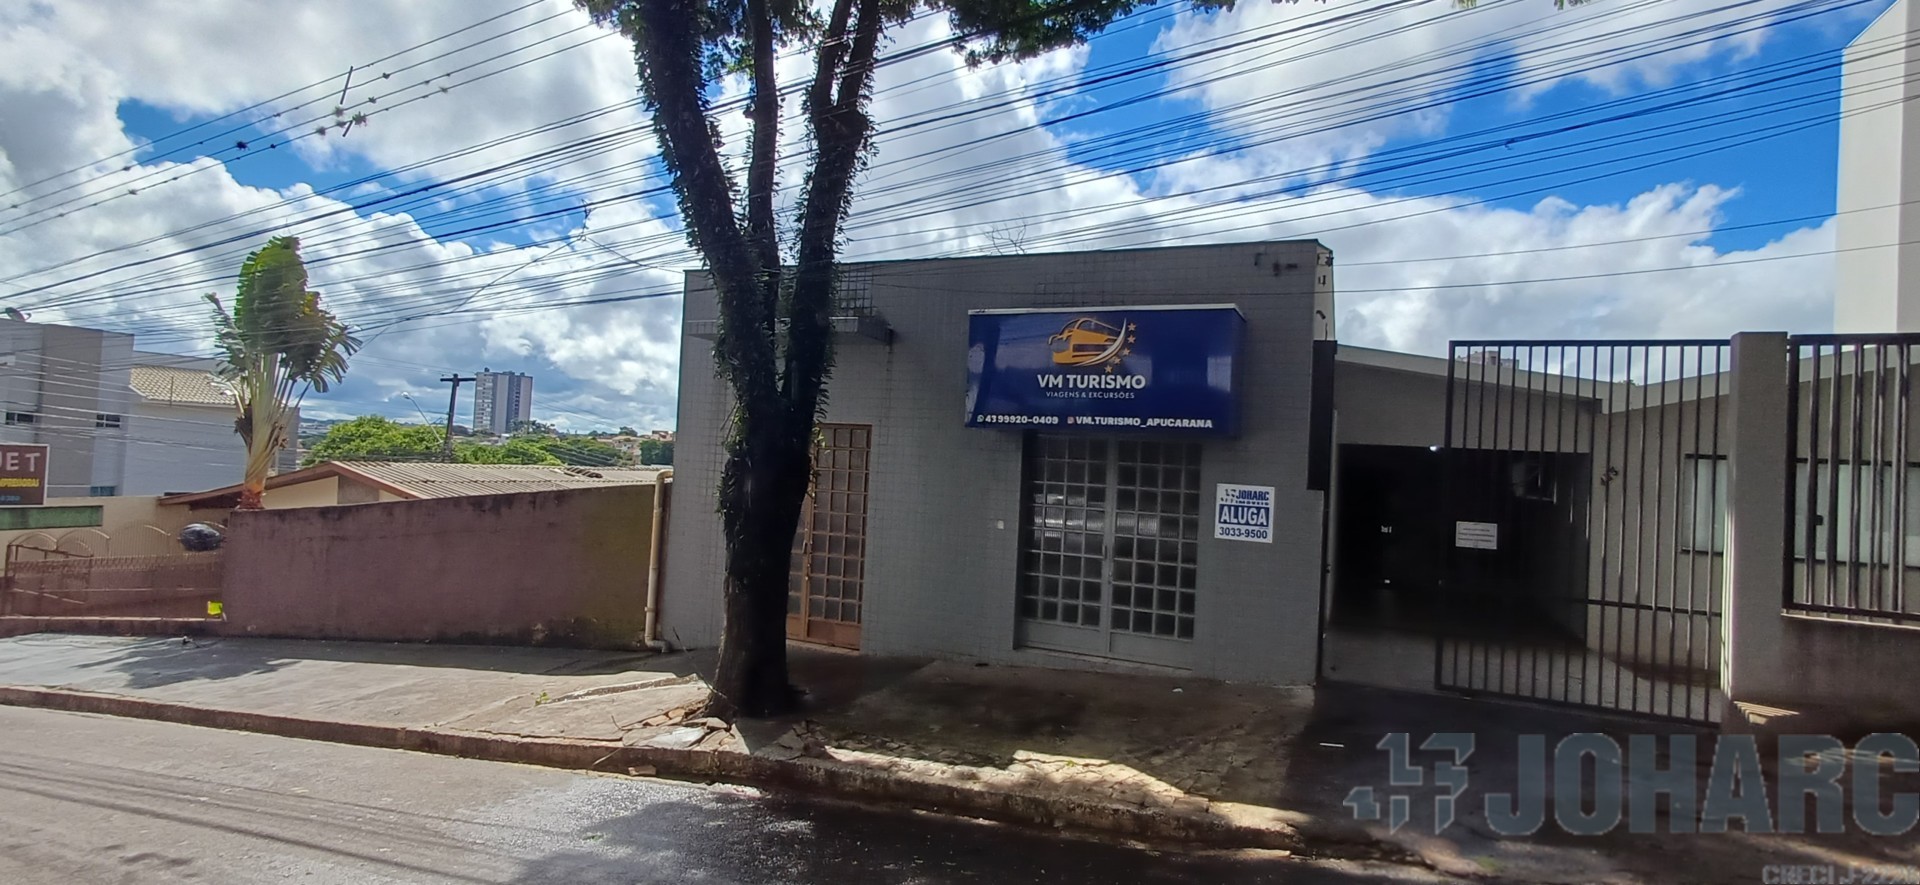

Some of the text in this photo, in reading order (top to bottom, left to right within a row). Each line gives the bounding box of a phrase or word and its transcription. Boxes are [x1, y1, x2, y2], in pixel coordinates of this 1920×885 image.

[1037, 374, 1146, 389] VM TURISMO
[1076, 416, 1213, 428] VM.TURISMO_APUCARANA
[0, 451, 41, 472] ET
[1236, 489, 1269, 500] JOHARC
[1220, 506, 1267, 525] ALUGA
[1219, 527, 1267, 539] 3033-9500
